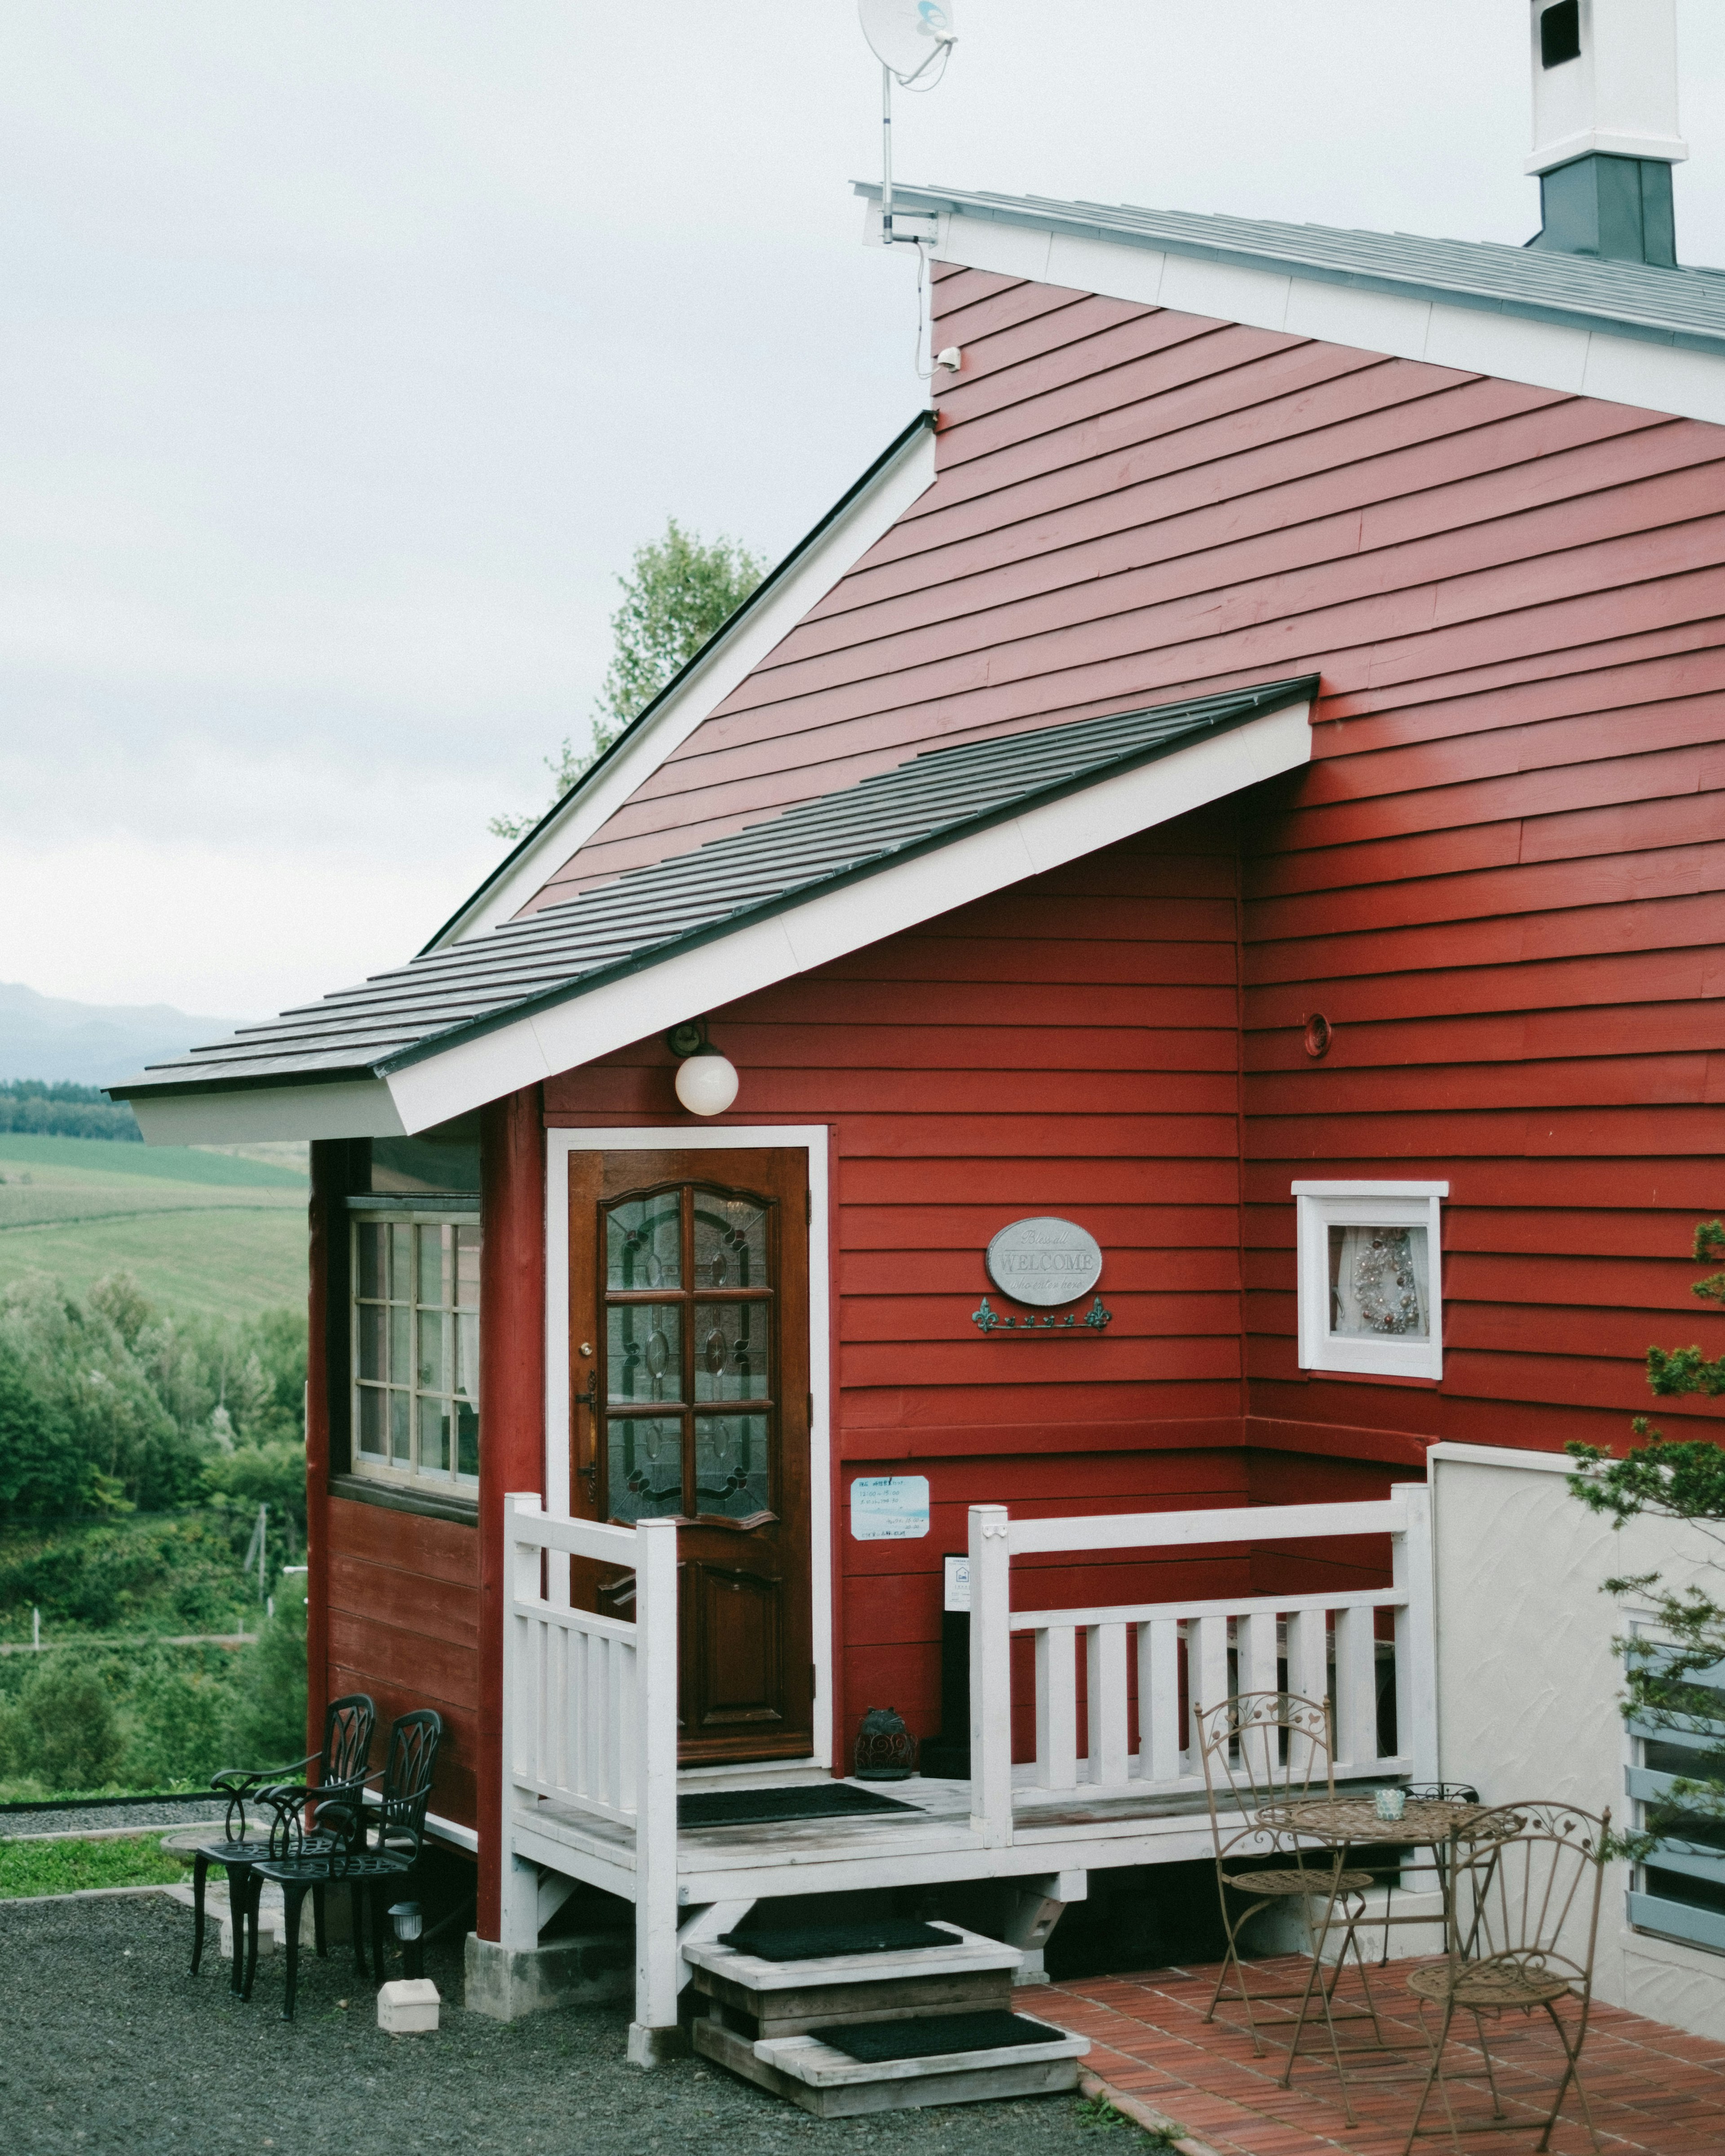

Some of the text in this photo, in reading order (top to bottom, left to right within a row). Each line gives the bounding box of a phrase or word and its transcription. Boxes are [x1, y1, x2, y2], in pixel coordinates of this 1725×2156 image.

[1021, 1230, 1069, 1244] Bless all
[998, 1252, 1093, 1272] WELCOME
[1010, 1277, 1082, 1290] who enter here
